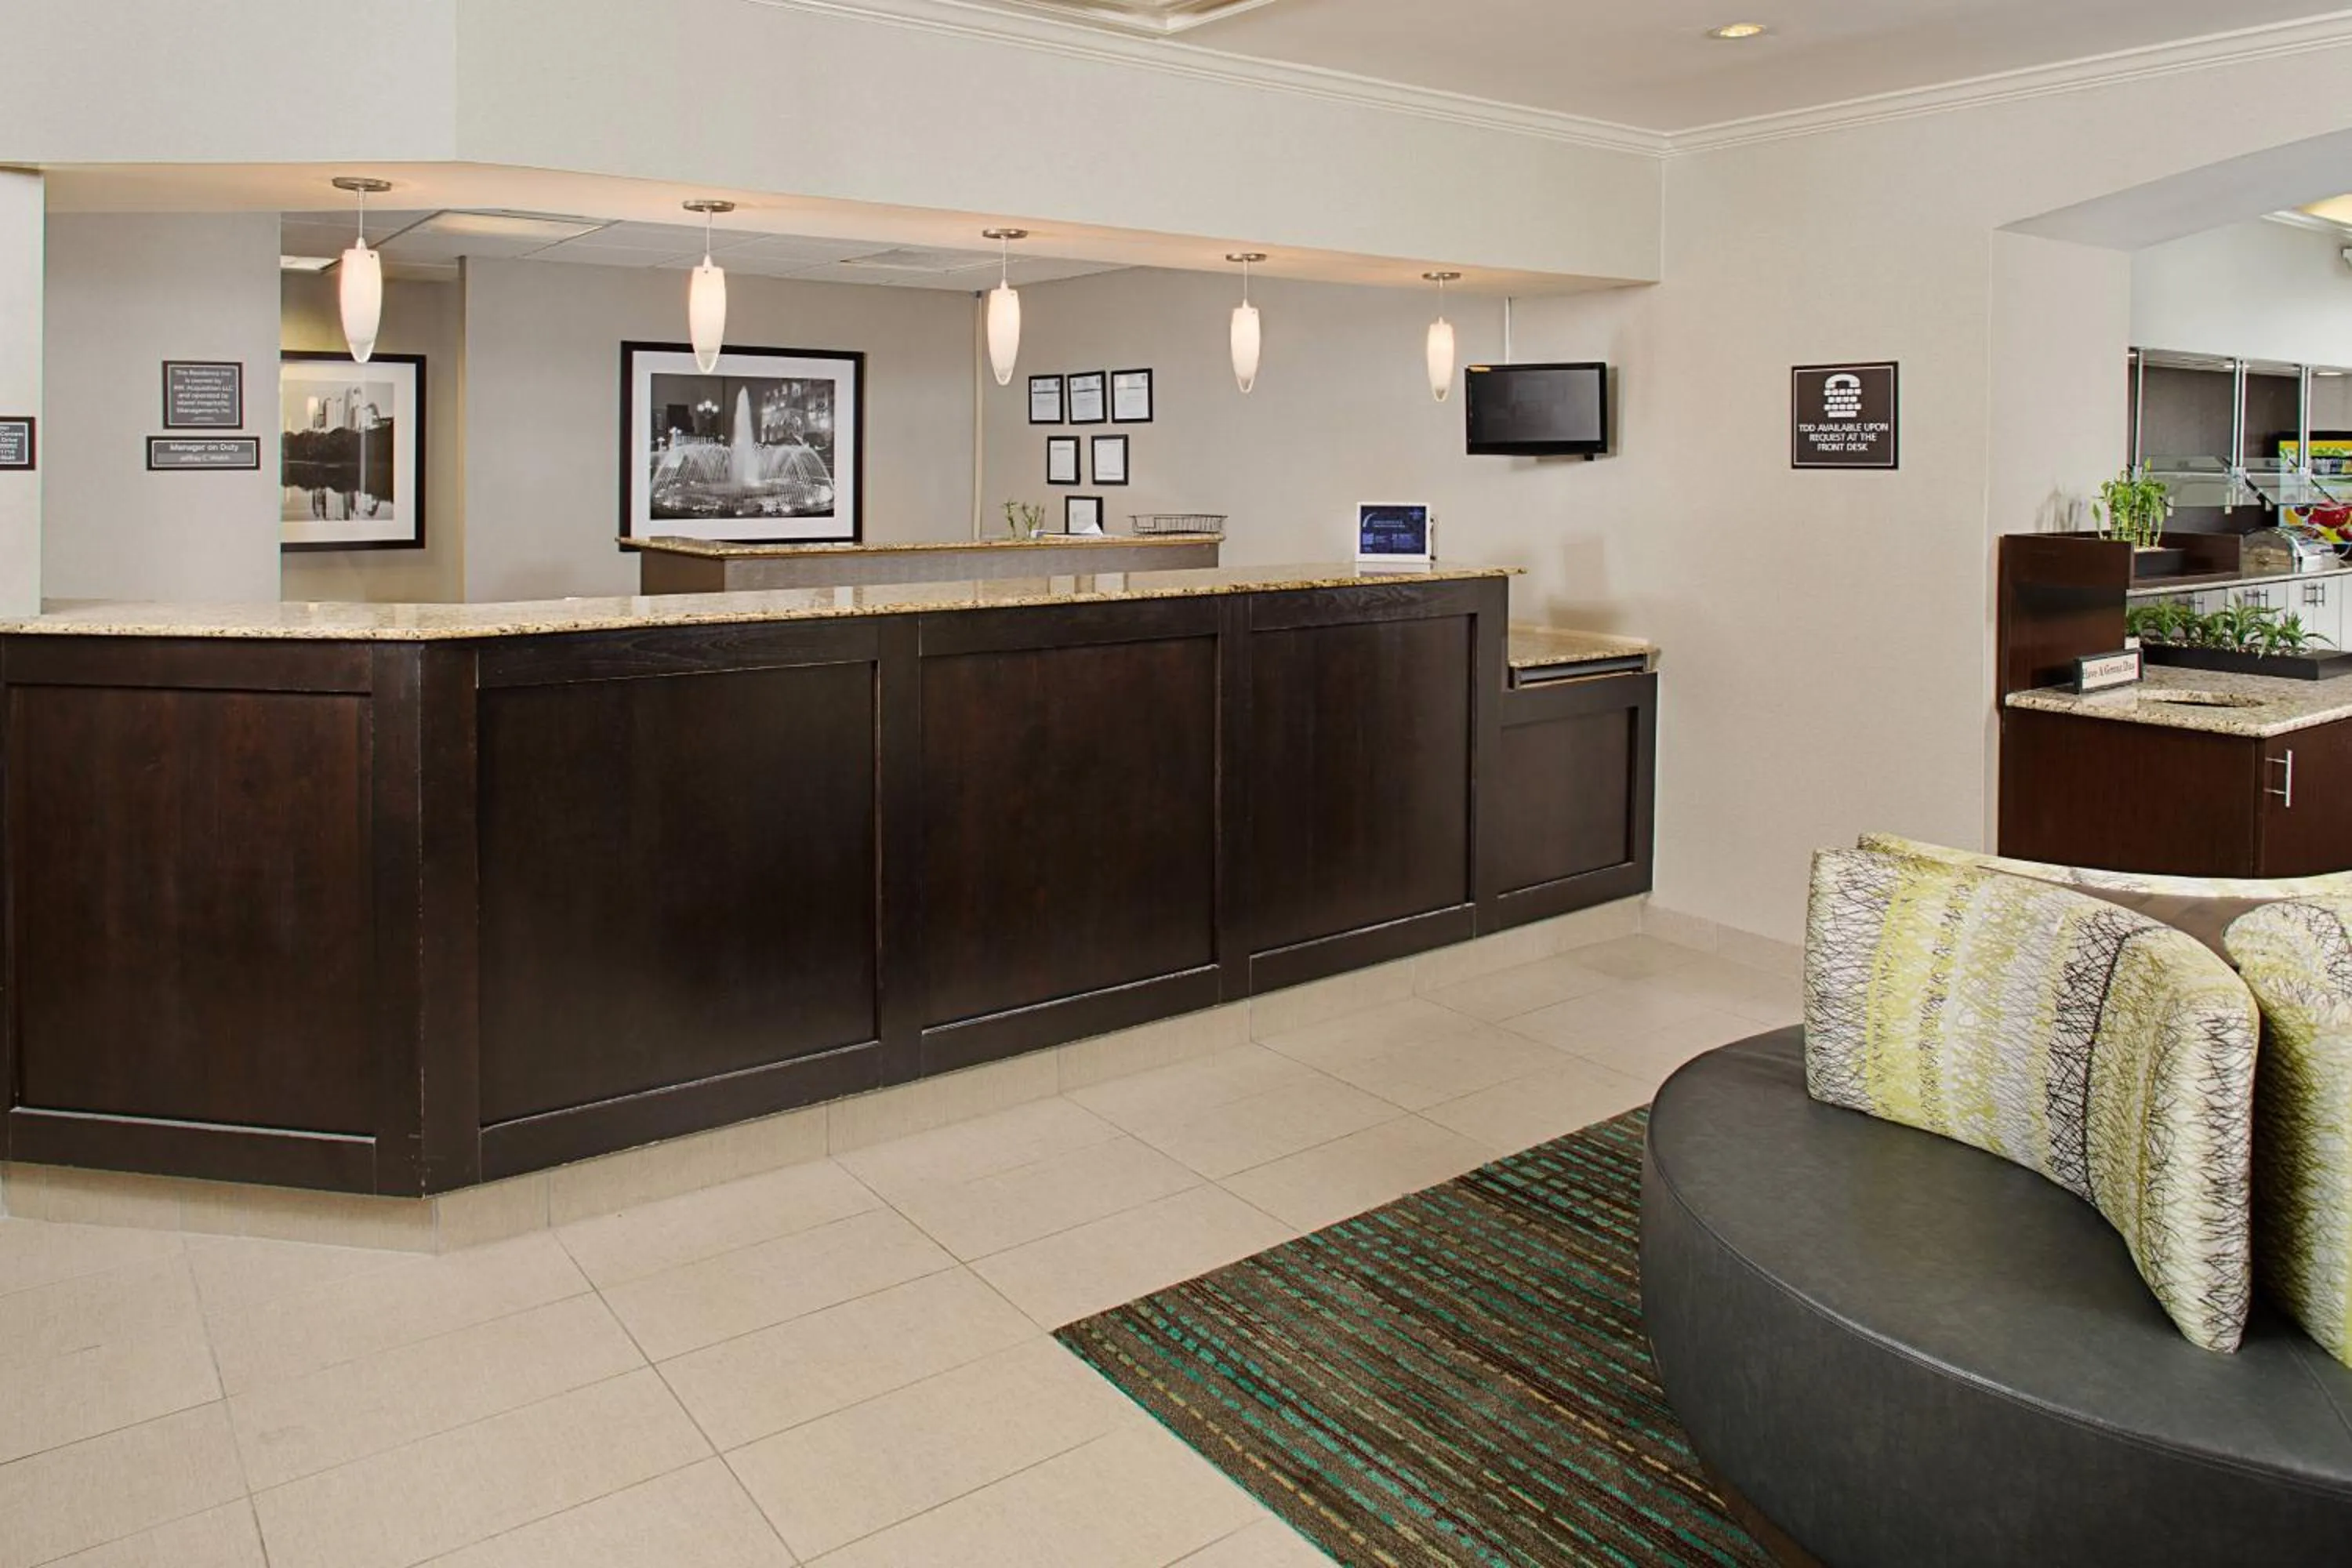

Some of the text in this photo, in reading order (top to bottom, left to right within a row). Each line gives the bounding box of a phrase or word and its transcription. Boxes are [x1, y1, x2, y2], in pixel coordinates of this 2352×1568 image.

[1817, 423, 1862, 432] AVAILABLE
[1864, 423, 1889, 432] UPON
[1809, 432, 1877, 442] REQUEST AT THE
[169, 443, 205, 452] Manager
[220, 443, 239, 452] Duty
[1817, 443, 1844, 452] FRONT
